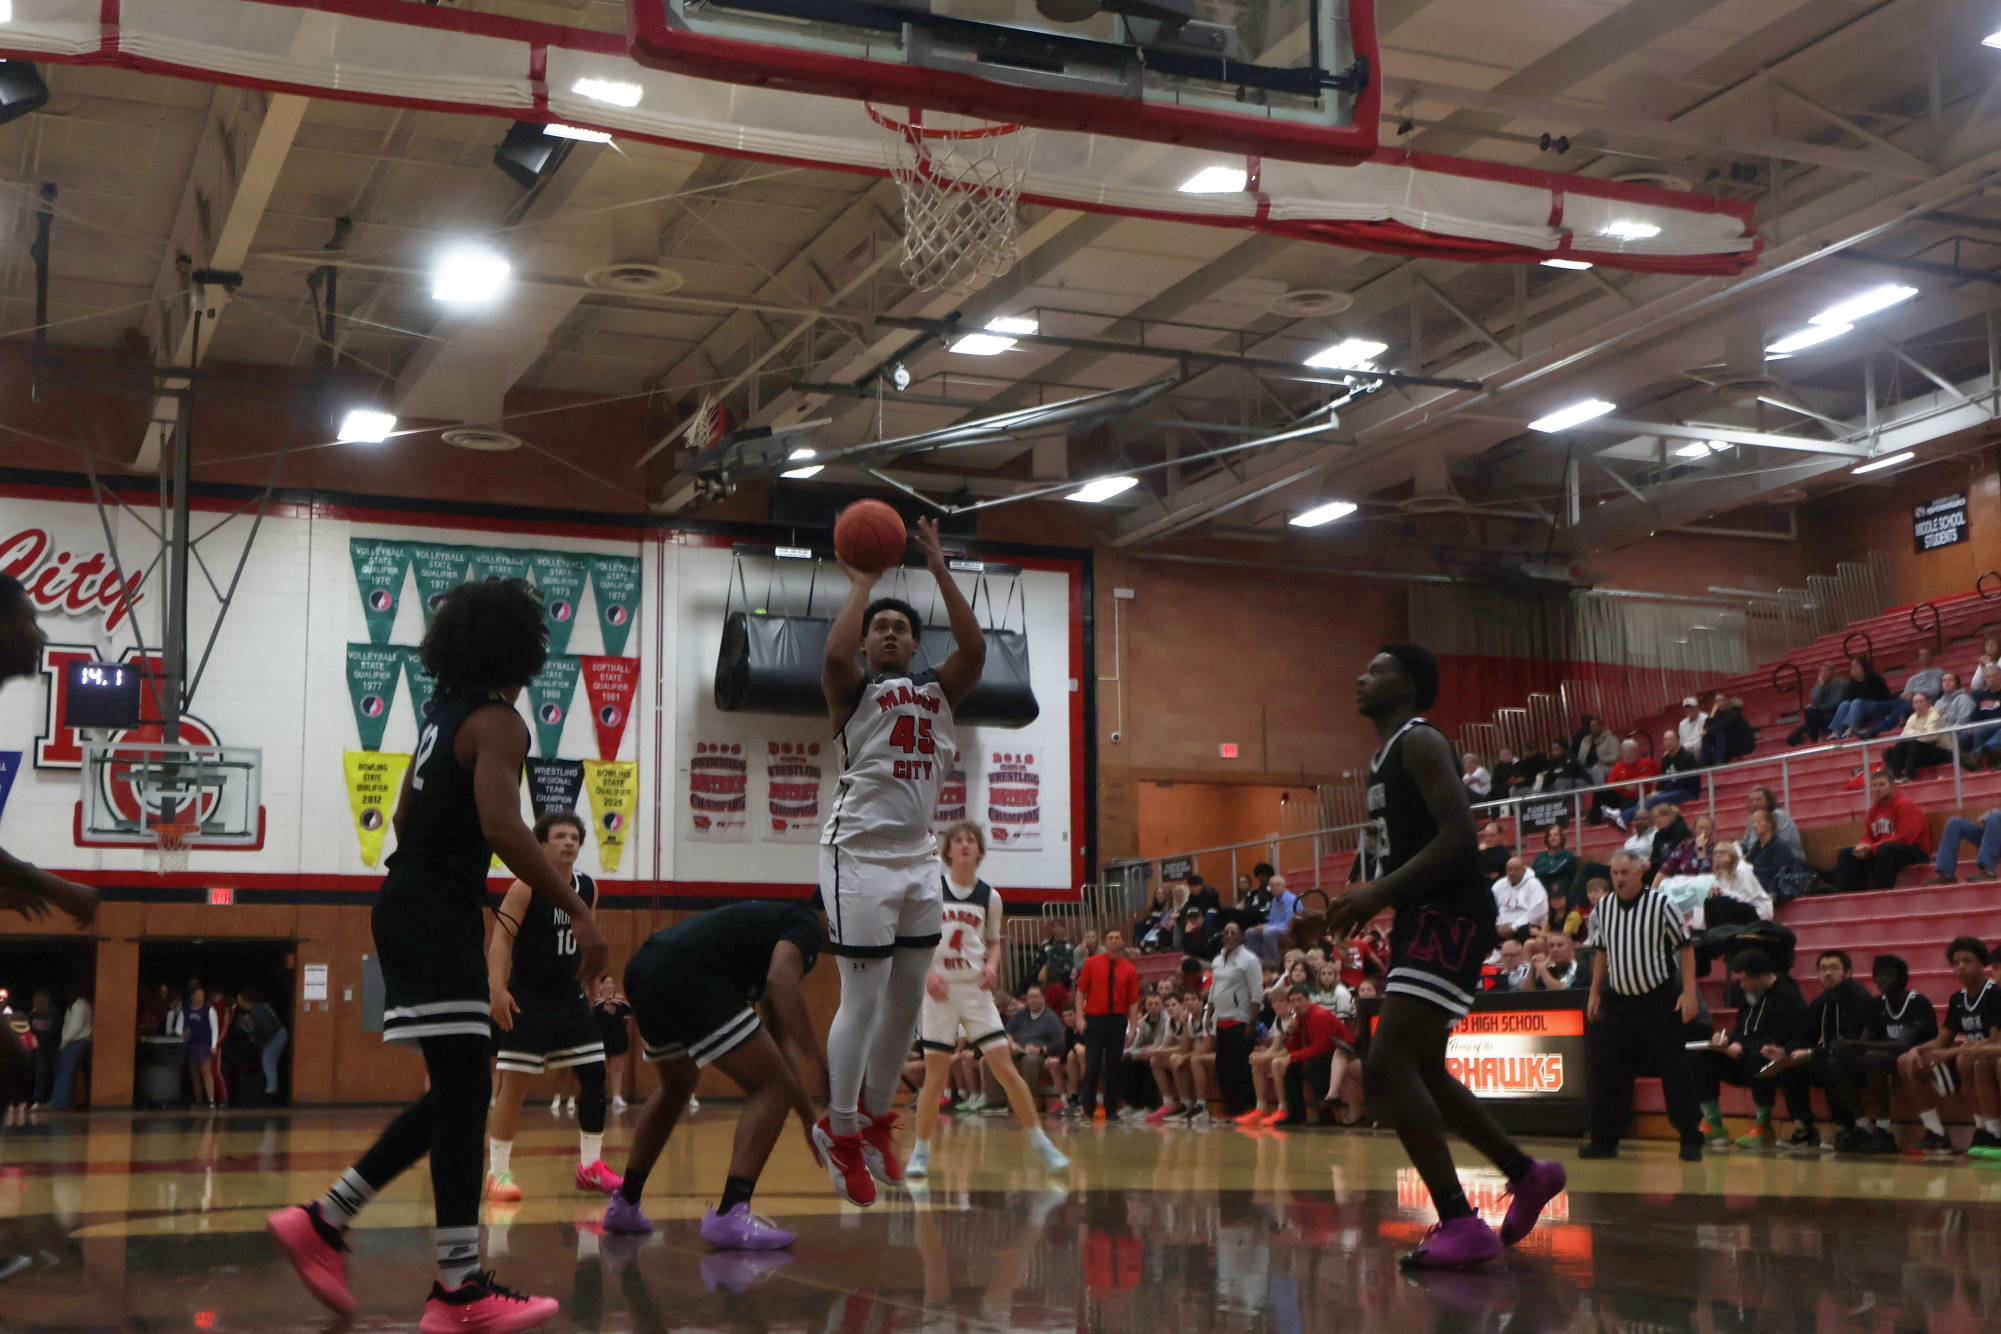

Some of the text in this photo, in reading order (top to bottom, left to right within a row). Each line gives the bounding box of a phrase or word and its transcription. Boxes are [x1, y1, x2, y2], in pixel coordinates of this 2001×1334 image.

[1915, 511, 1966, 537] MIDDLE SCHOOL
[1924, 527, 1958, 549] STUDENTS
[356, 547, 406, 558] VOLLEYBALL
[415, 550, 465, 562] VOLLEYBALL
[368, 557, 392, 566] STATE
[428, 561, 452, 570] STATE
[475, 555, 524, 566] VOLLEYBALL
[361, 565, 399, 575] QUALIFIER
[421, 569, 459, 579] QUALIFIER
[489, 565, 512, 573] STATE
[549, 568, 573, 577] STATE
[371, 576, 391, 586] 1970
[542, 576, 579, 586] QUALIFIER
[606, 572, 628, 582] STATE
[430, 580, 450, 589] 1971
[600, 581, 635, 591] QUALIFIER
[551, 587, 571, 597] 1973
[347, 651, 397, 662] VOLLEYBALL
[360, 662, 385, 670] STATE
[592, 663, 630, 673] SOFTBALL
[82, 667, 122, 686] 14.1
[353, 670, 391, 680] QUALIFIER
[600, 673, 622, 682] STATE
[362, 681, 382, 691] 1977
[532, 679, 569, 689] QUALIFIER
[593, 682, 628, 691] QUALIFIER
[542, 690, 560, 699] 1980
[602, 692, 620, 702] 1981
[890, 715, 936, 754] 45
[358, 763, 388, 772] BOWLING
[691, 756, 747, 772] SWIMMING
[534, 766, 578, 778] WRESTLING
[597, 769, 632, 779] BOWLING
[767, 764, 821, 779] WRESTLING
[893, 760, 932, 780] CITY
[363, 774, 382, 782] STATE
[537, 777, 572, 786] REGIONAL
[603, 779, 625, 787] STATE
[690, 772, 748, 794] DISTRICT
[988, 771, 1040, 787] WRESTLING
[356, 784, 388, 792] QUALIFIER
[596, 787, 632, 796] QUALIFIER
[769, 781, 819, 801] DISTRICT
[362, 795, 382, 805] 2012
[536, 794, 573, 804] CHAMPION
[989, 787, 1039, 807] DISTRICT
[603, 798, 623, 807] 2025
[690, 793, 746, 813] CHAMPION
[769, 801, 818, 818] CHAMPION
[988, 806, 1040, 825] CHAMPION
[557, 928, 577, 955] 10
[949, 930, 963, 952] 4
[1472, 1016, 1499, 1033] HIGH
[1501, 1014, 1548, 1031] SCHOOL
[1449, 1038, 1471, 1053] Home
[1483, 1041, 1494, 1050] the
